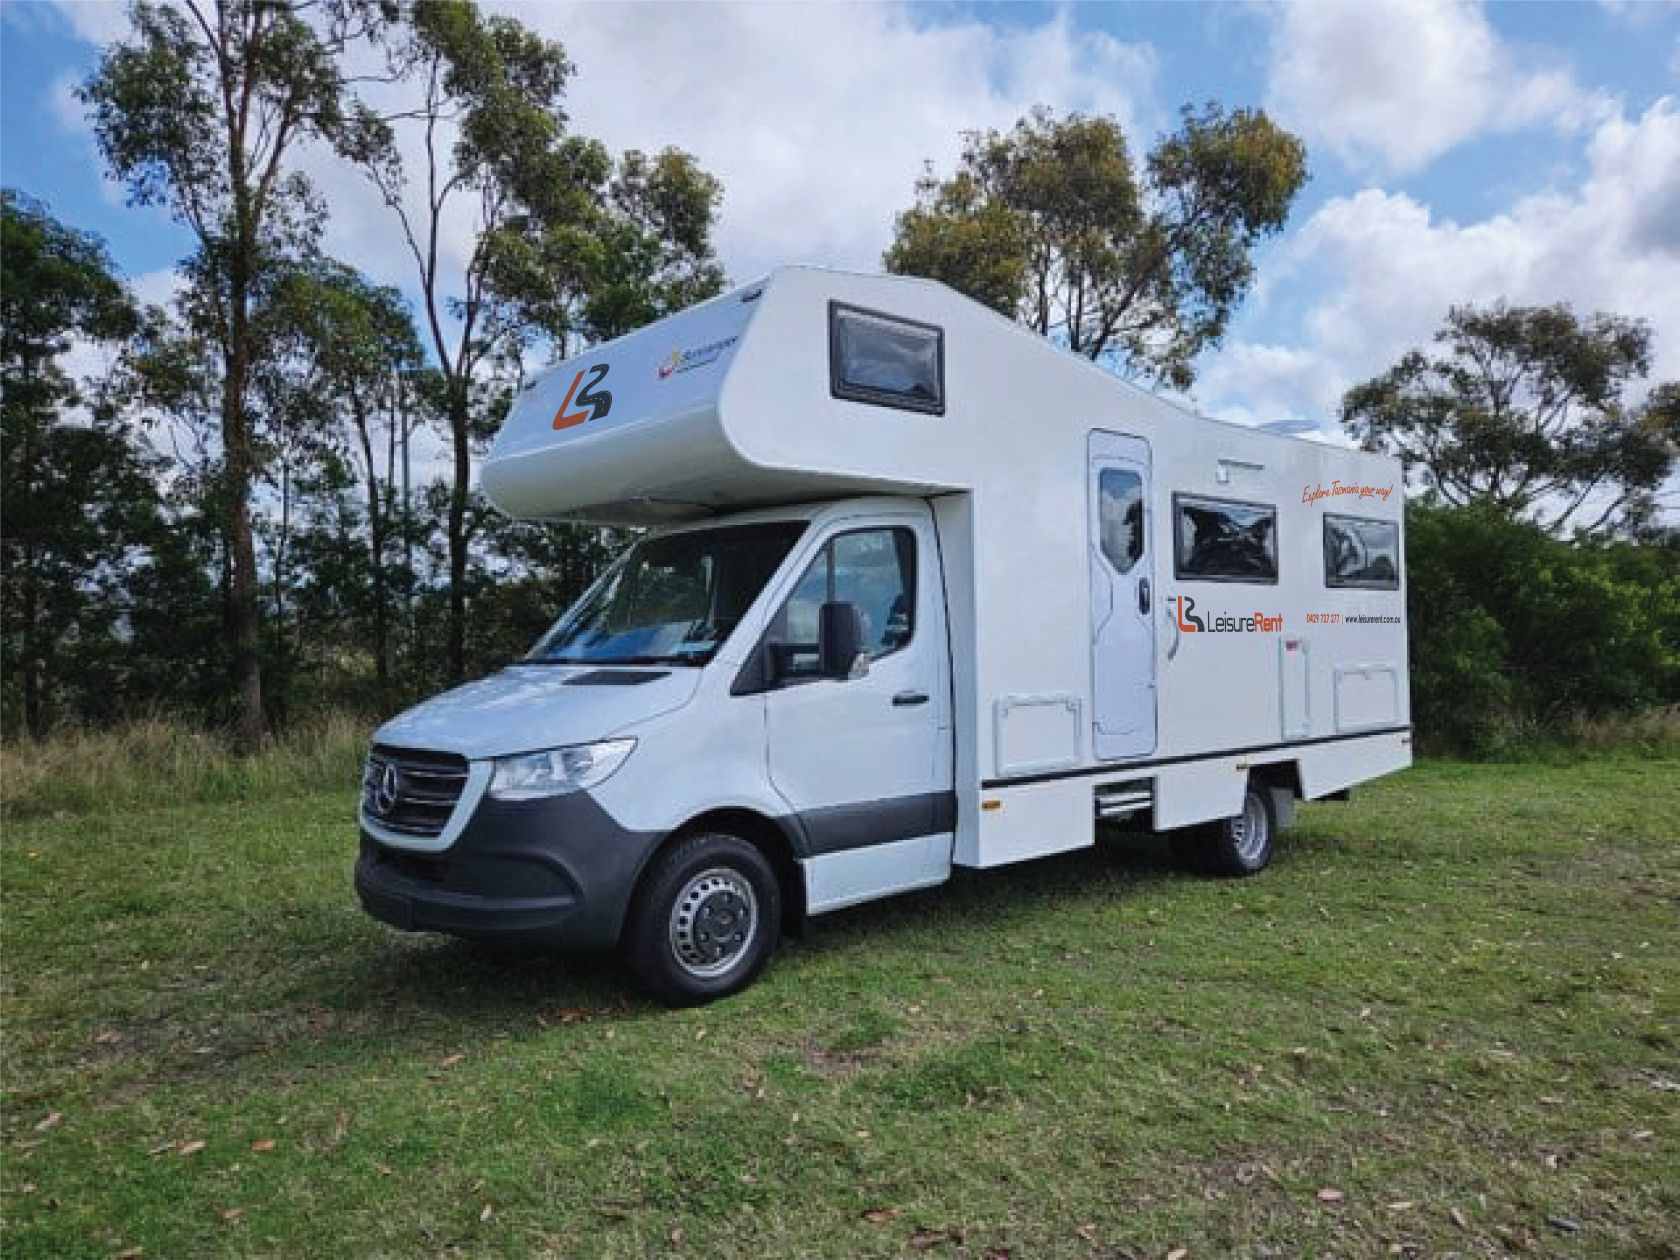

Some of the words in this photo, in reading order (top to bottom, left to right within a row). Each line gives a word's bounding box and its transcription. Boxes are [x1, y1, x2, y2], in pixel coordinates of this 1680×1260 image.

[1302, 484, 1330, 507] Explore
[1331, 480, 1359, 496] Tasmania
[1358, 486, 1375, 499] your
[1207, 611, 1283, 633] LeisureRent
